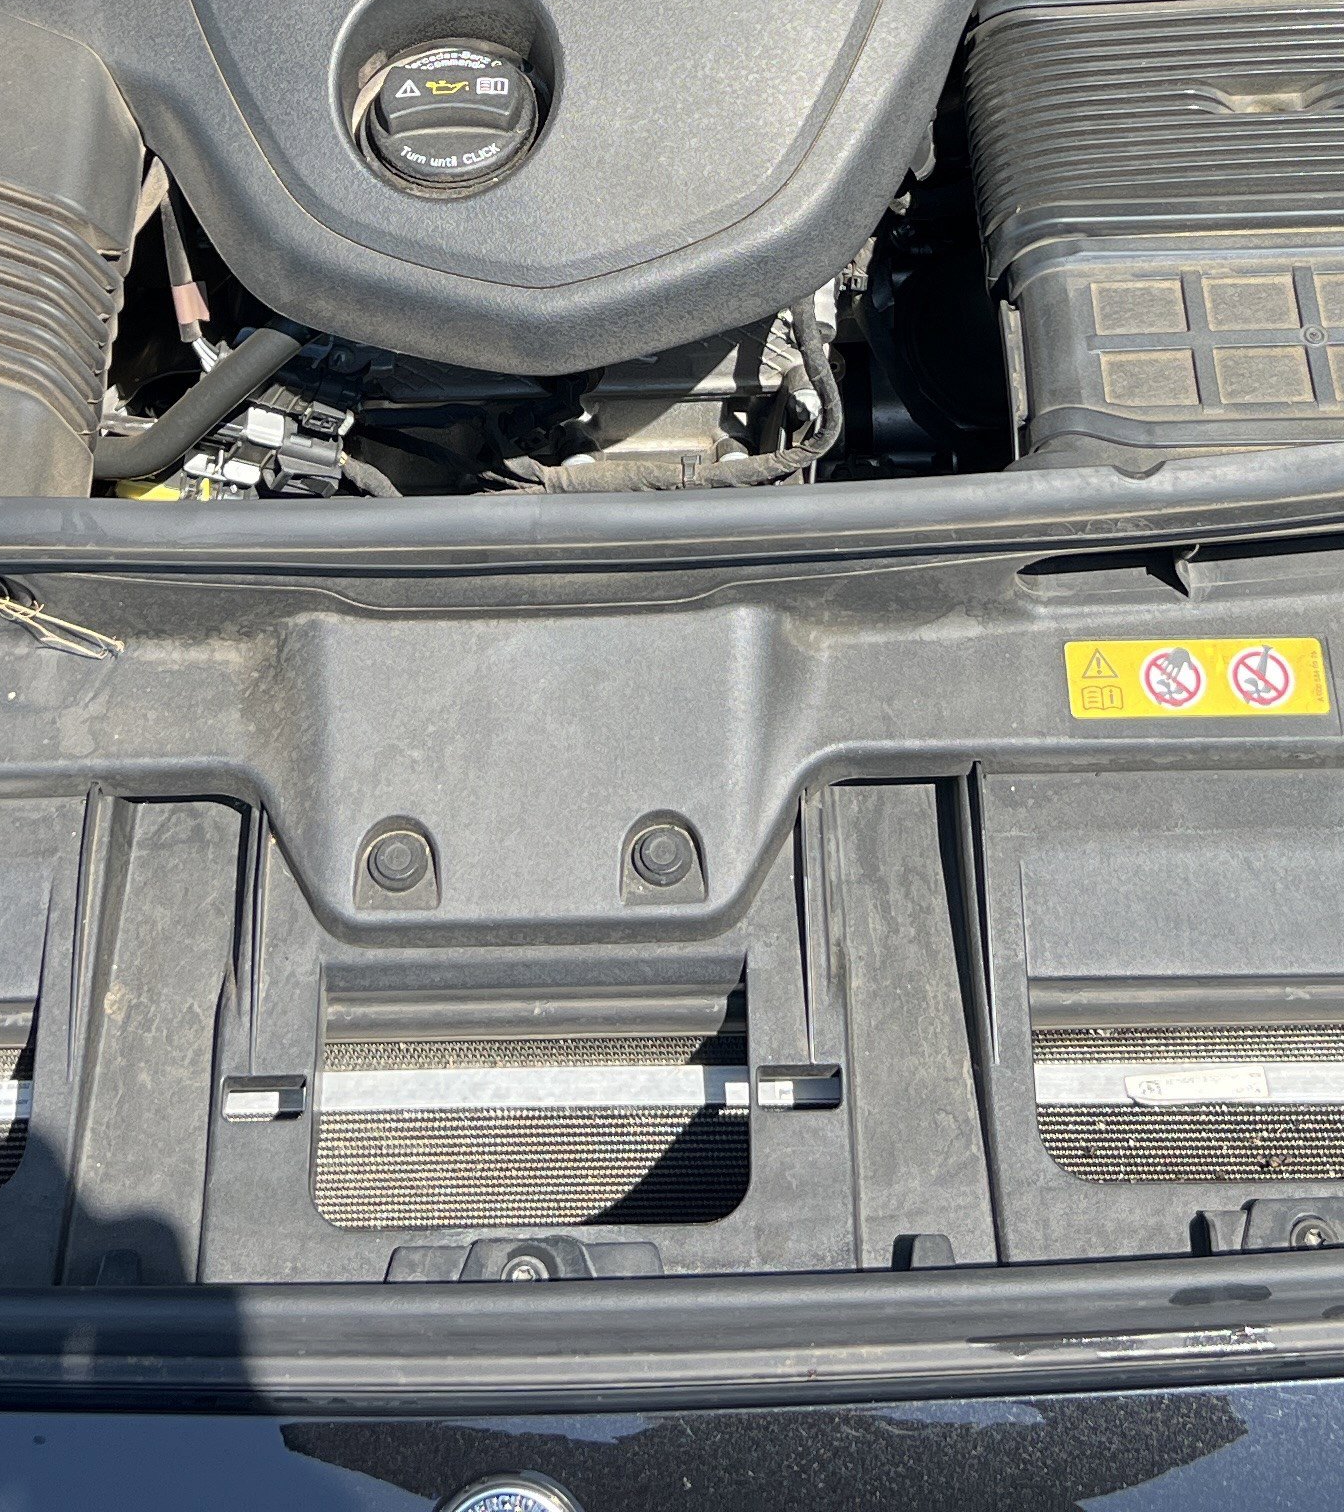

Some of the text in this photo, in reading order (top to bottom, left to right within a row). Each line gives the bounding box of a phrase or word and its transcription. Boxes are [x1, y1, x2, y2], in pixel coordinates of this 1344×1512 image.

[400, 143, 500, 167] Turn until CLICK
